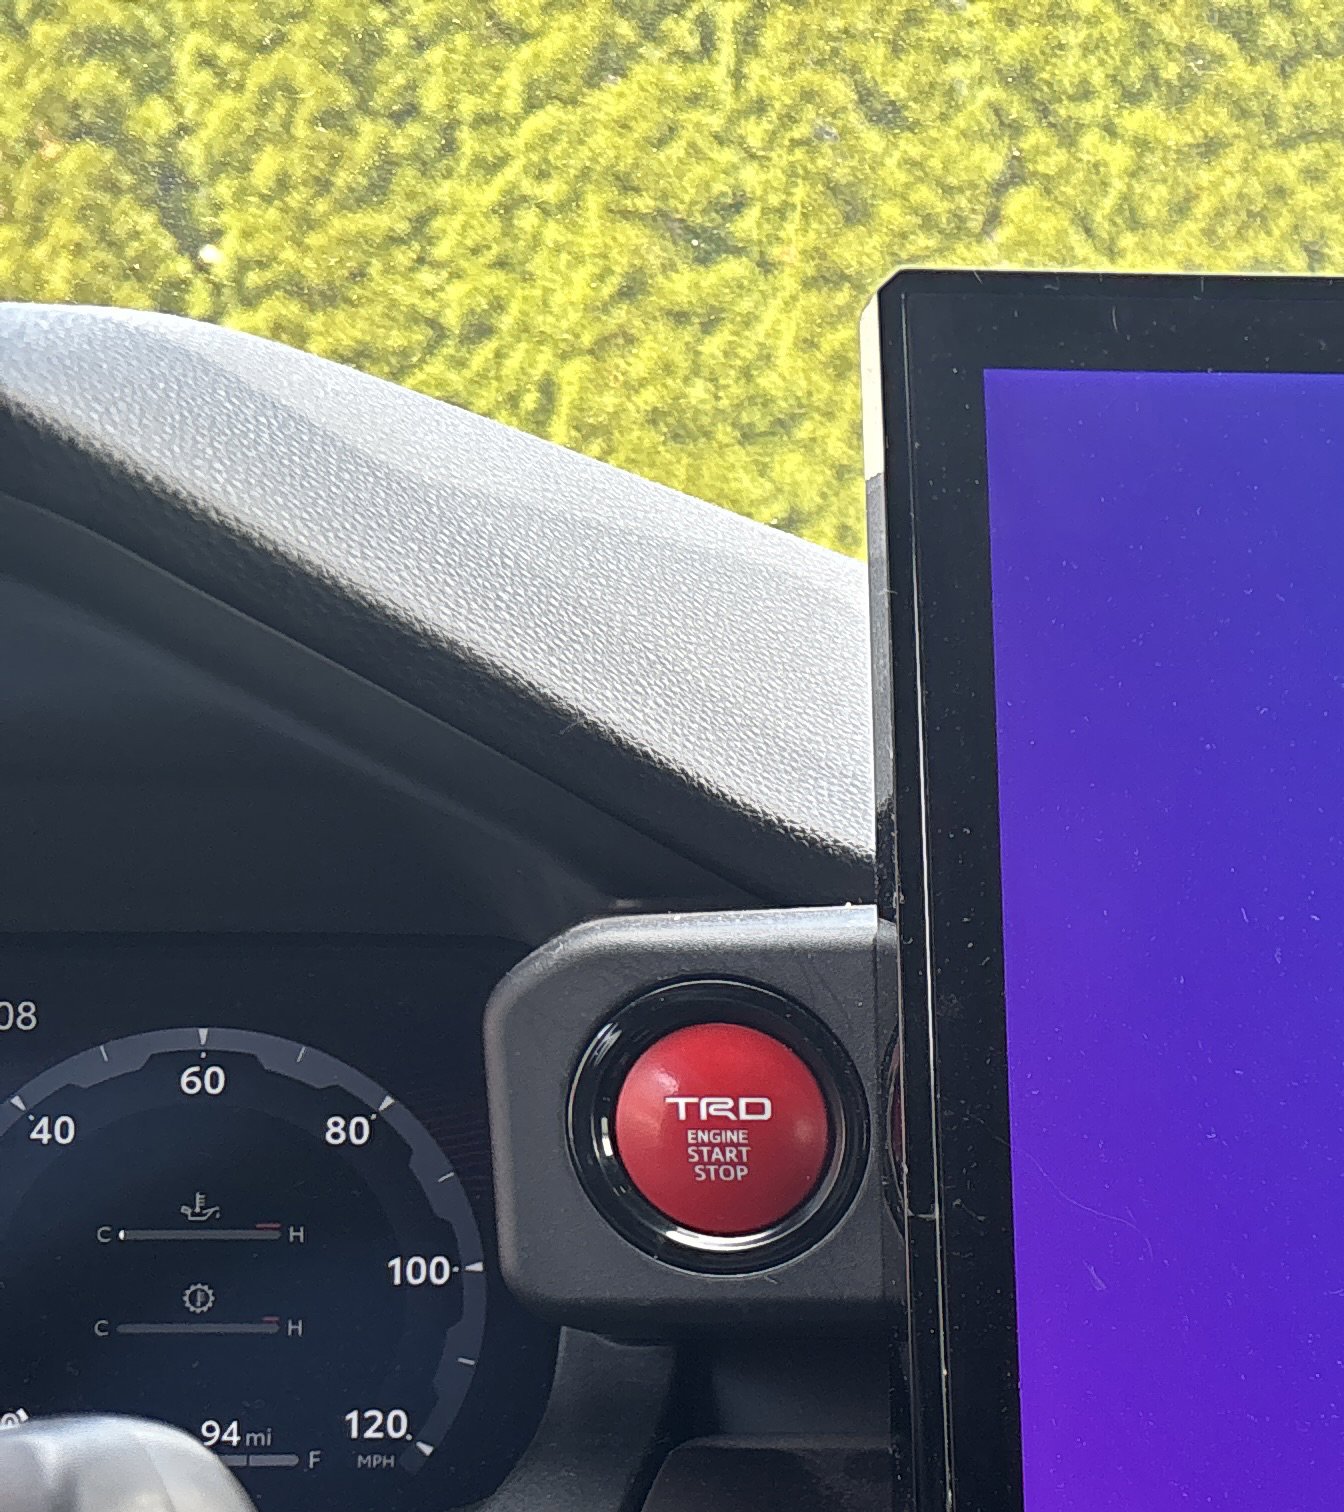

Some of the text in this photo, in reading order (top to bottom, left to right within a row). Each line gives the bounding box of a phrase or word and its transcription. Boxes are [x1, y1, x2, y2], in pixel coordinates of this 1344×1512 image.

[180, 1066, 226, 1096] 60
[664, 1097, 772, 1121] TRD
[29, 1115, 76, 1146] 40
[324, 1116, 370, 1146] 80
[687, 1129, 749, 1144] ENGINE
[687, 1146, 751, 1163] START
[694, 1165, 748, 1181] STOP
[96, 1226, 112, 1244] C
[288, 1226, 305, 1244] H
[387, 1255, 451, 1287] 100
[94, 1319, 109, 1337] C
[287, 1319, 303, 1337] H
[345, 1410, 408, 1438] 120
[245, 1427, 272, 1447] mi
[308, 1450, 321, 1469] F
[357, 1453, 395, 1469] MPH
